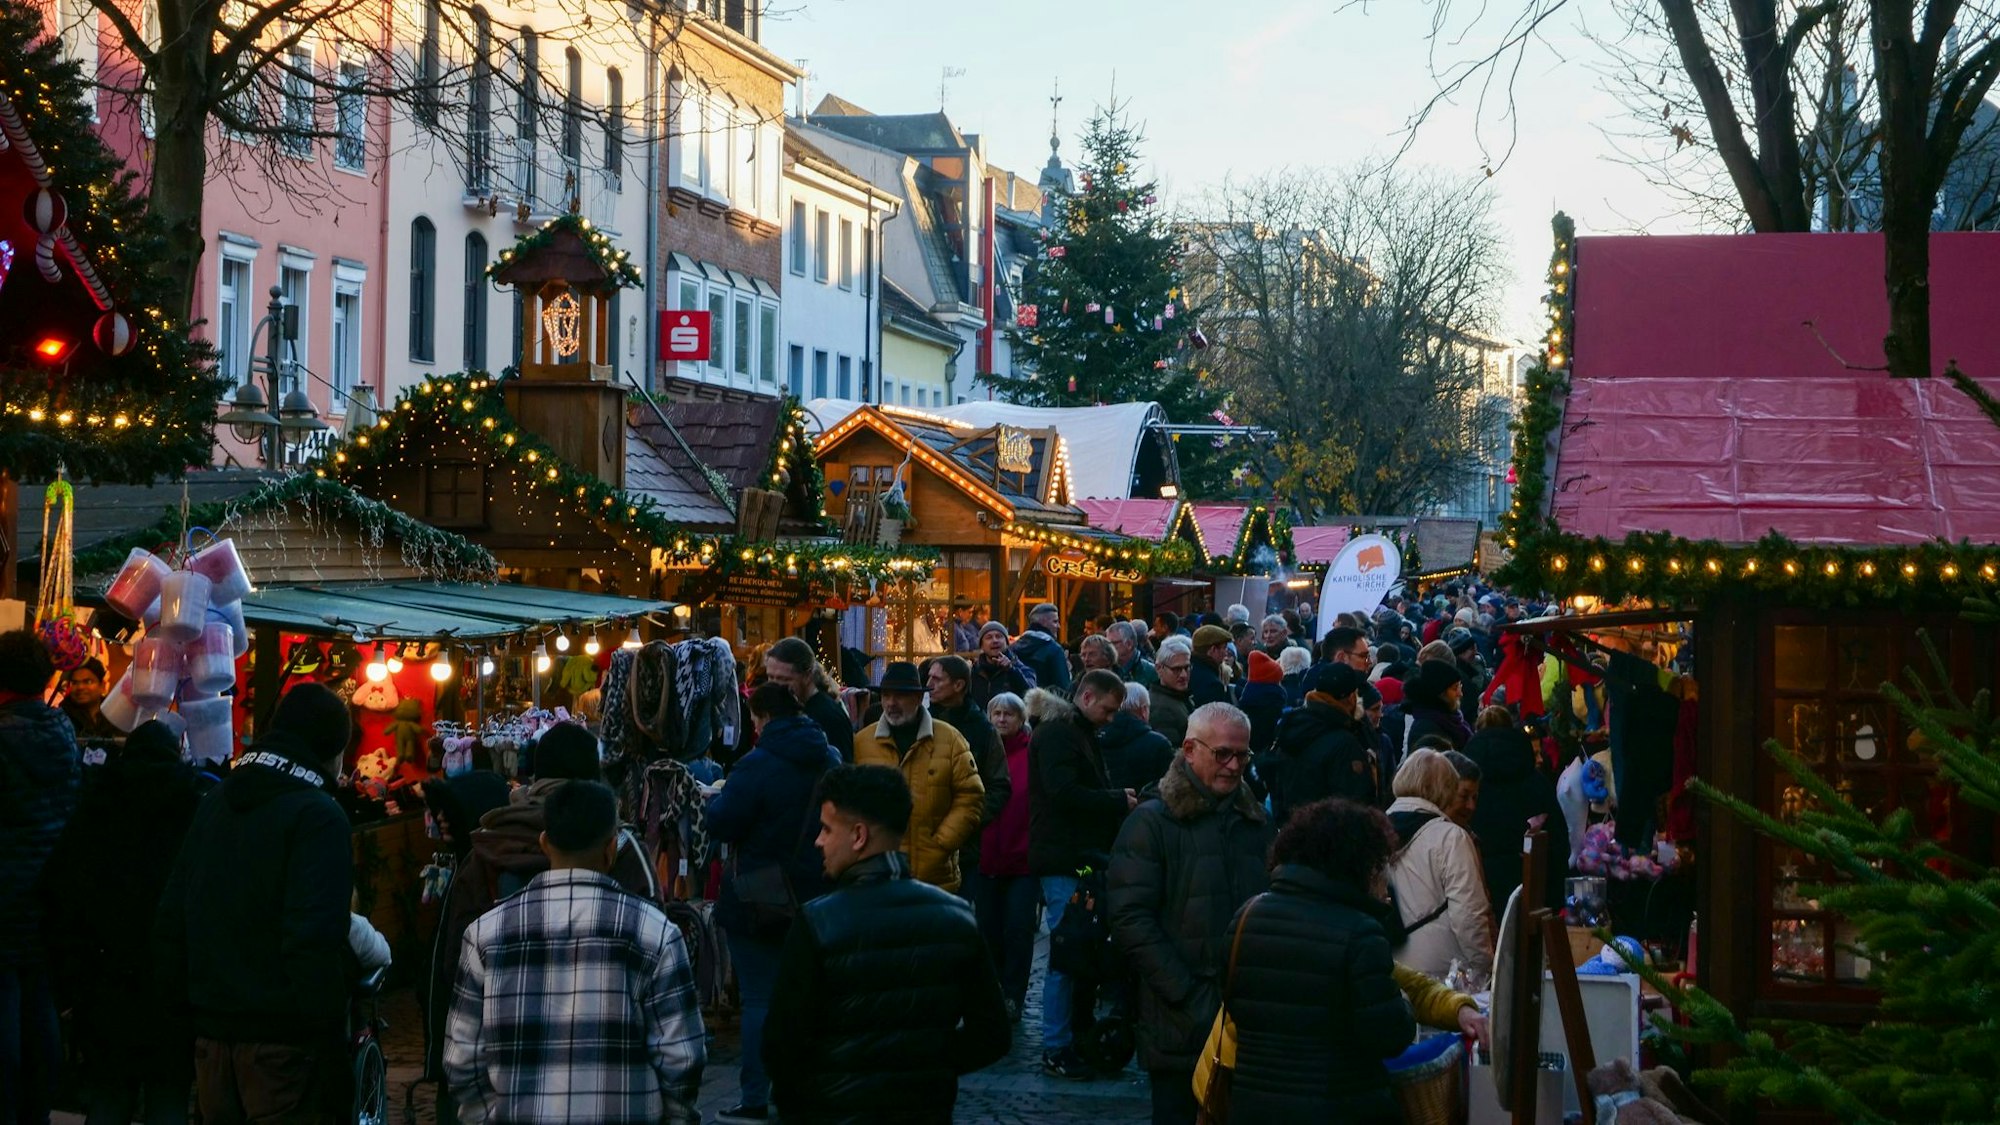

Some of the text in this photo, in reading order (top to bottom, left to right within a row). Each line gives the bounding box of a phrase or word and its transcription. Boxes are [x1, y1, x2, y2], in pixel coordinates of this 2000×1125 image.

[729, 576, 783, 588] REIBEKUCHEN
[1333, 574, 1385, 583] KATHOLISCHE
[1357, 581, 1386, 589] KIRCHE
[255, 752, 289, 771] EST.
[289, 762, 324, 787] 1982
